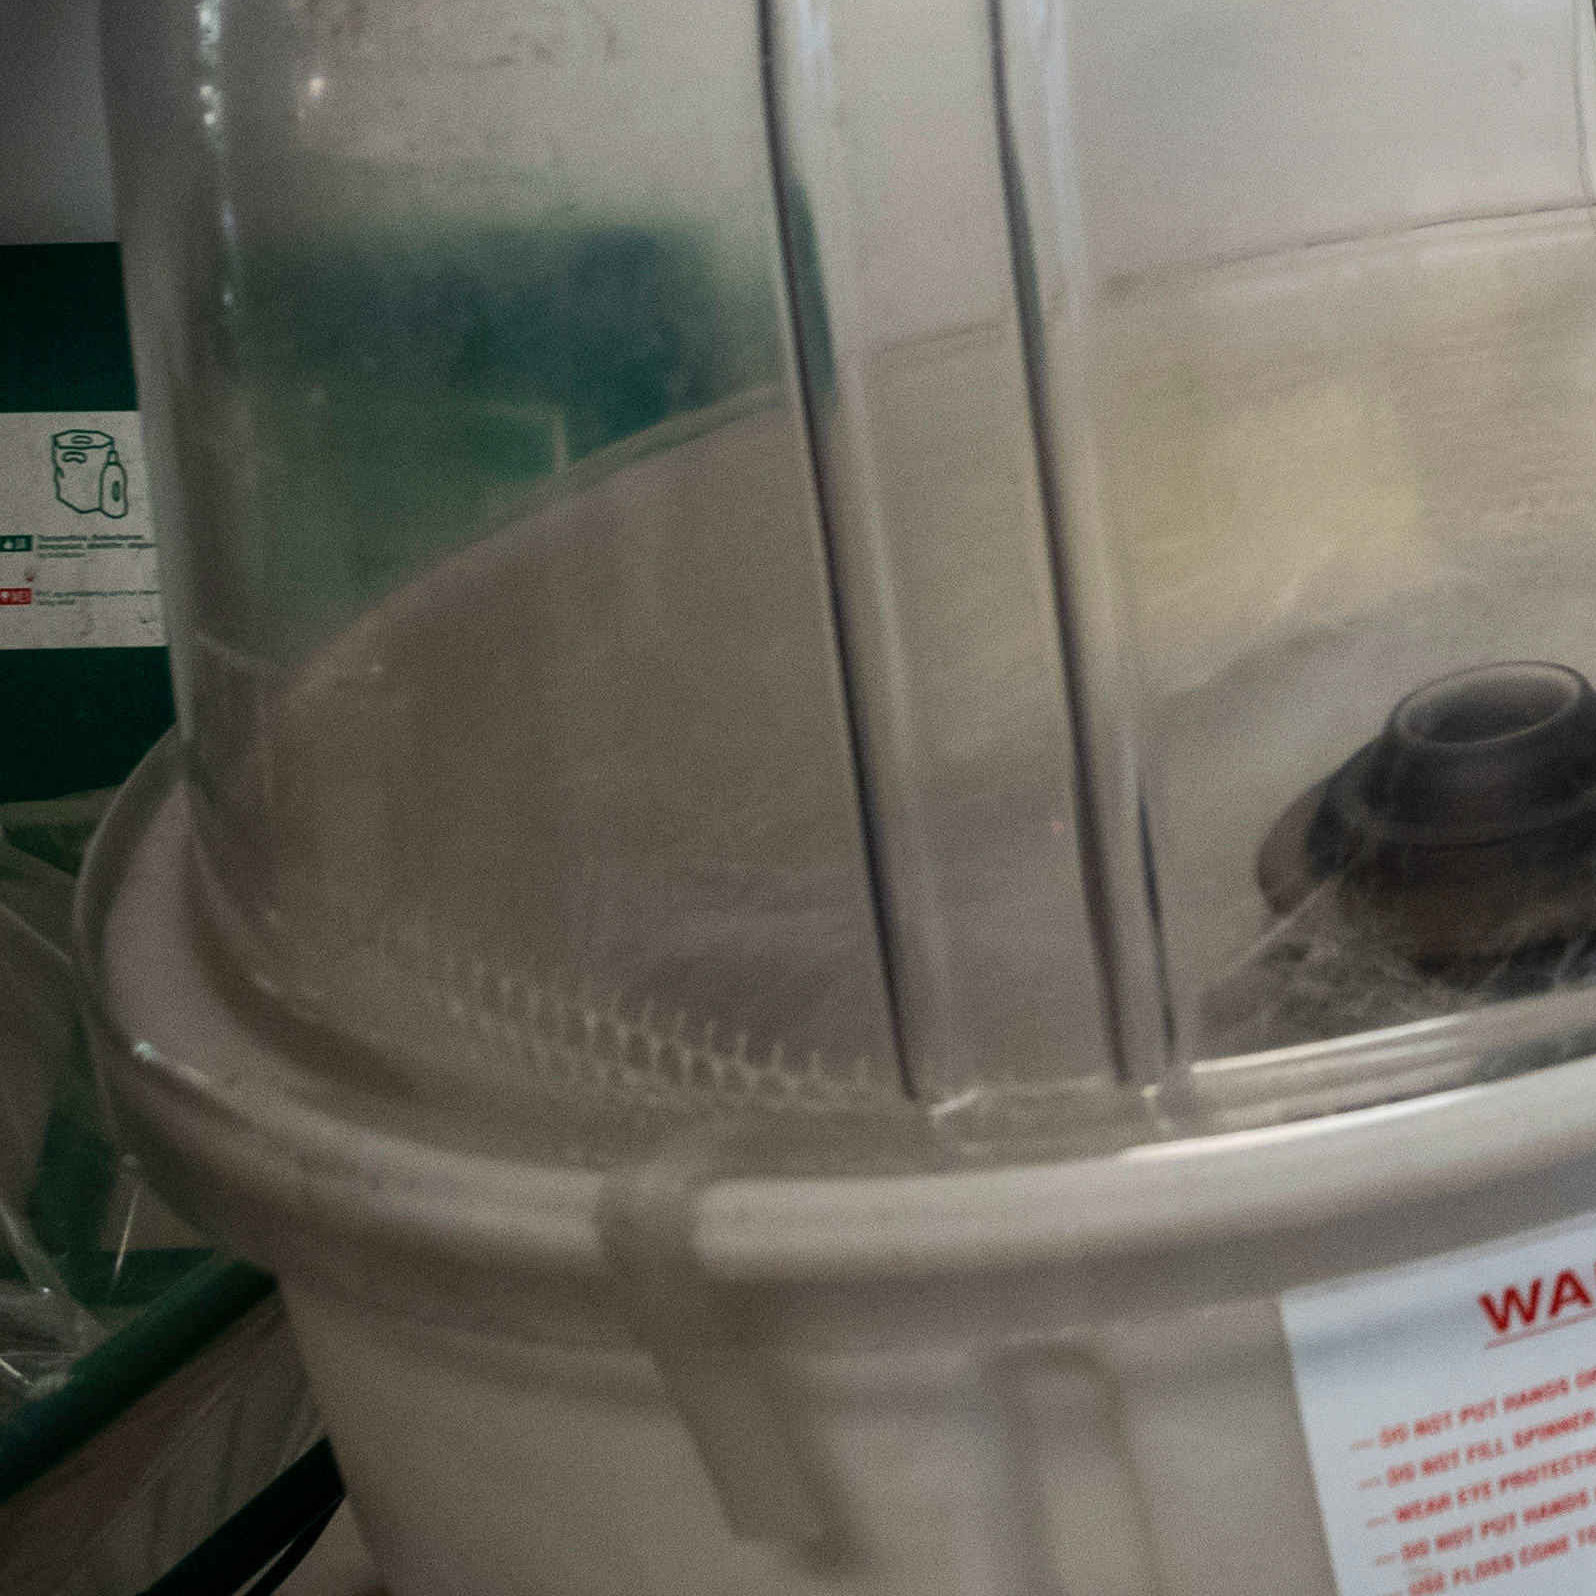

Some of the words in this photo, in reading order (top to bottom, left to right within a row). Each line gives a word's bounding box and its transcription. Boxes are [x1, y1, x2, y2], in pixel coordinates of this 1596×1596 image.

[1380, 1424, 1408, 1447] DO
[1413, 1412, 1452, 1437] NOT
[1460, 1400, 1496, 1423] PUT
[1503, 1378, 1570, 1411] HANDS
[1387, 1463, 1415, 1486] DO
[1420, 1450, 1459, 1476] NOT
[1465, 1435, 1504, 1463] FILL
[1513, 1409, 1596, 1449] SPINNER
[1395, 1492, 1452, 1524] WEAR
[1457, 1480, 1493, 1507] EYE
[1402, 1539, 1430, 1562] DO
[1435, 1525, 1473, 1552] NOT
[1480, 1512, 1517, 1539] PUT
[1523, 1490, 1589, 1524] HANDS
